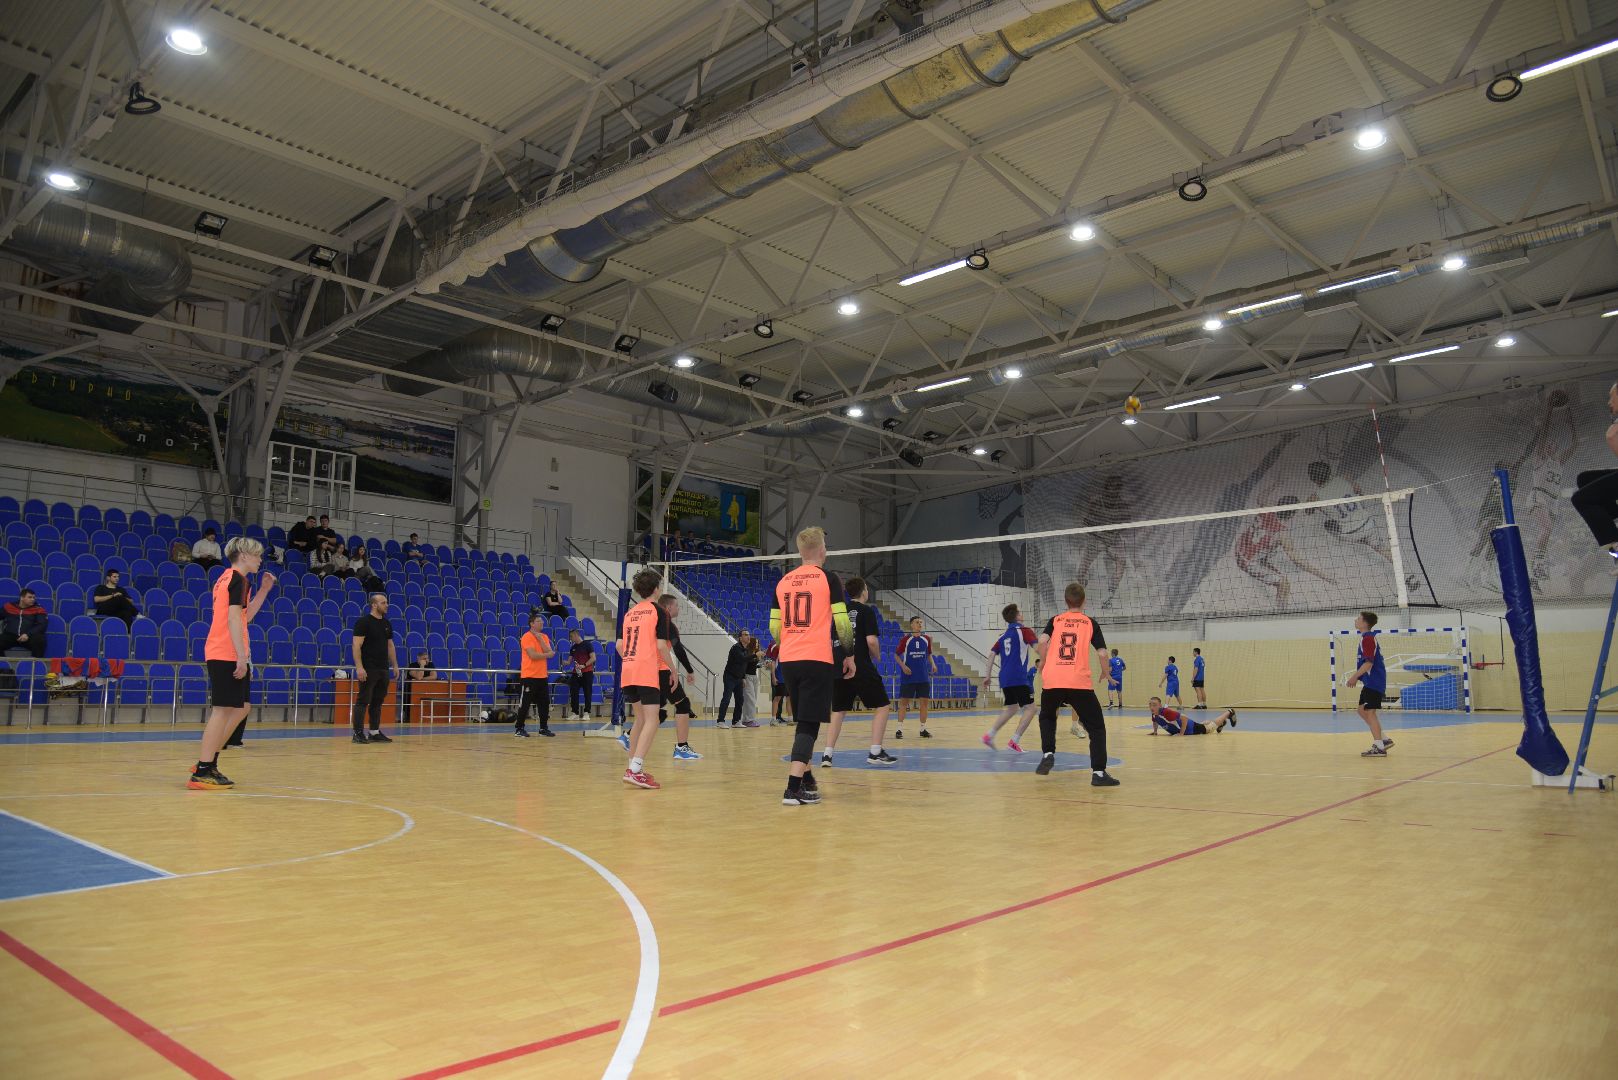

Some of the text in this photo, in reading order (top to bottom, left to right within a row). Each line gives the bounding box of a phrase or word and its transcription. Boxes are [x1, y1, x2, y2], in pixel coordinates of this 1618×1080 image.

[784, 591, 812, 628] 10
[624, 626, 640, 657] 11
[1059, 631, 1077, 660] 8
